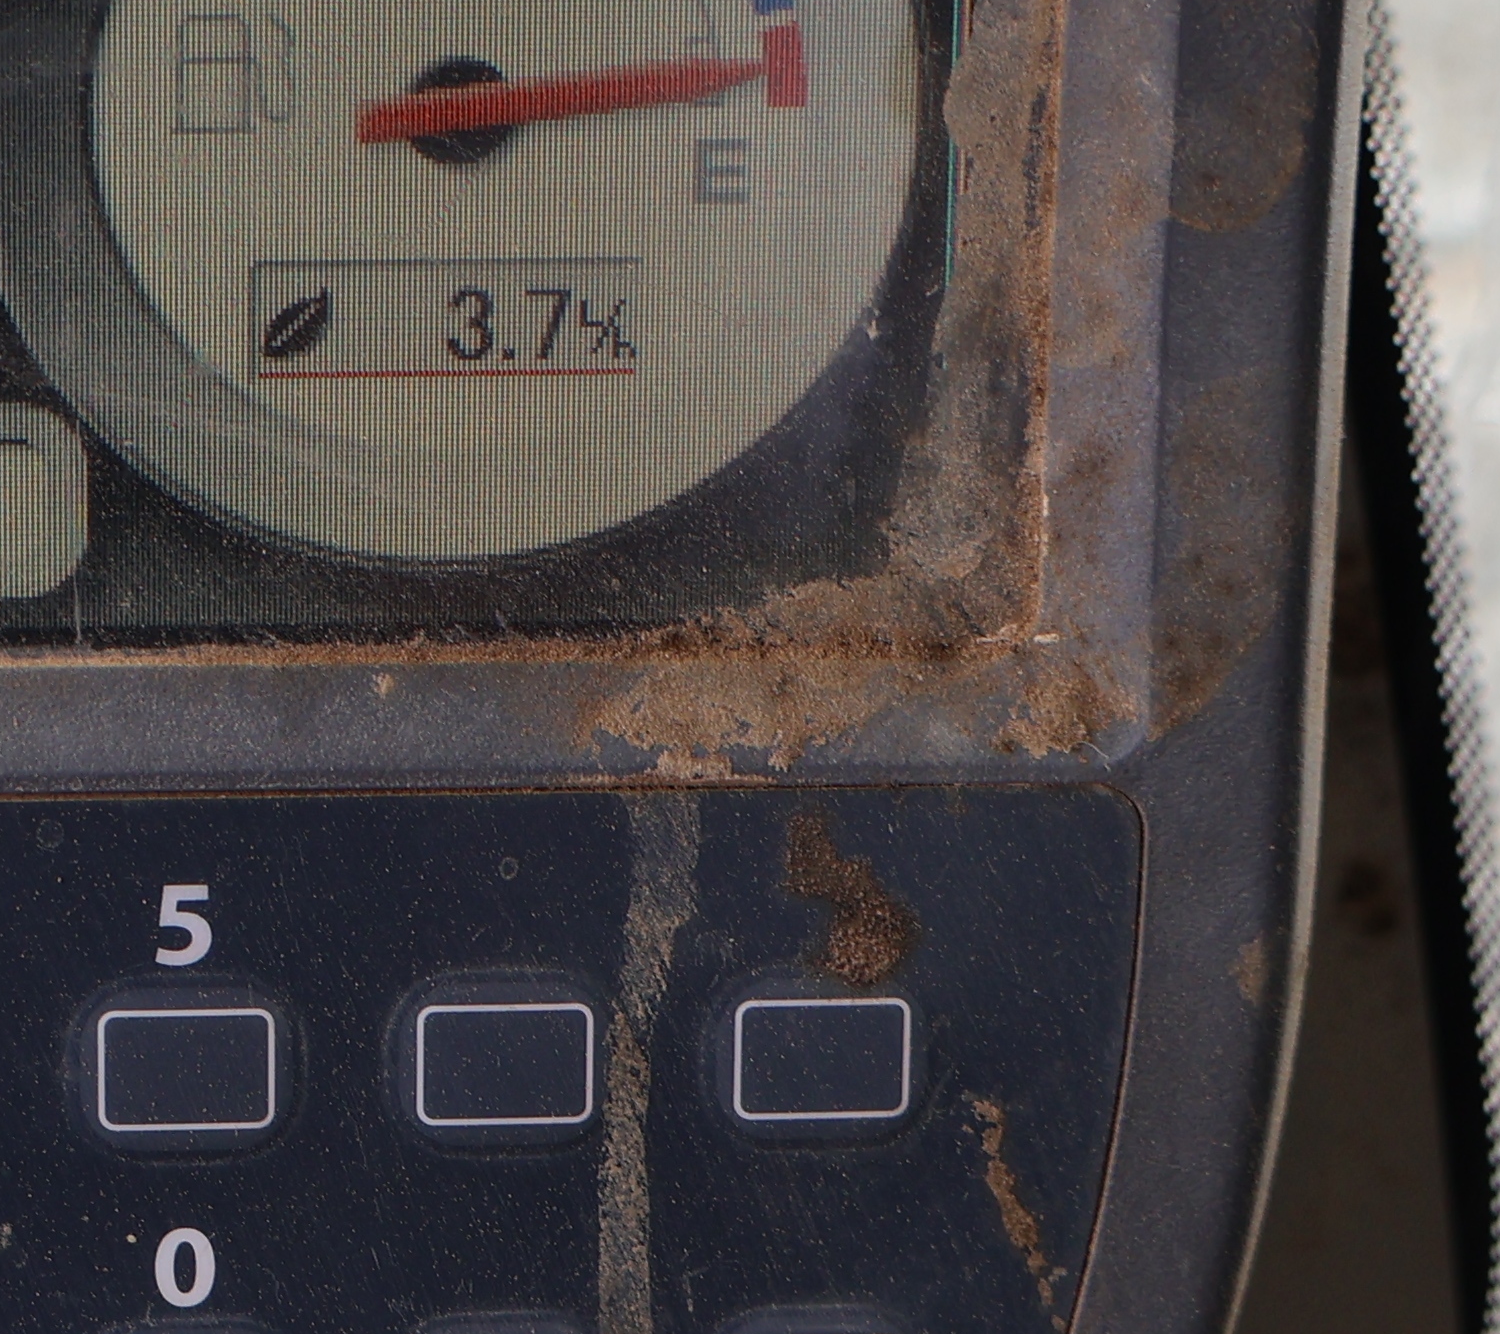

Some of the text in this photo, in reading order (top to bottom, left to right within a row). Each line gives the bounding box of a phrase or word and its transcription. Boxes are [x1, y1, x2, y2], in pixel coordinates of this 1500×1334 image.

[694, 138, 749, 205] E
[157, 885, 213, 965] 5
[155, 1227, 216, 1307] 0
